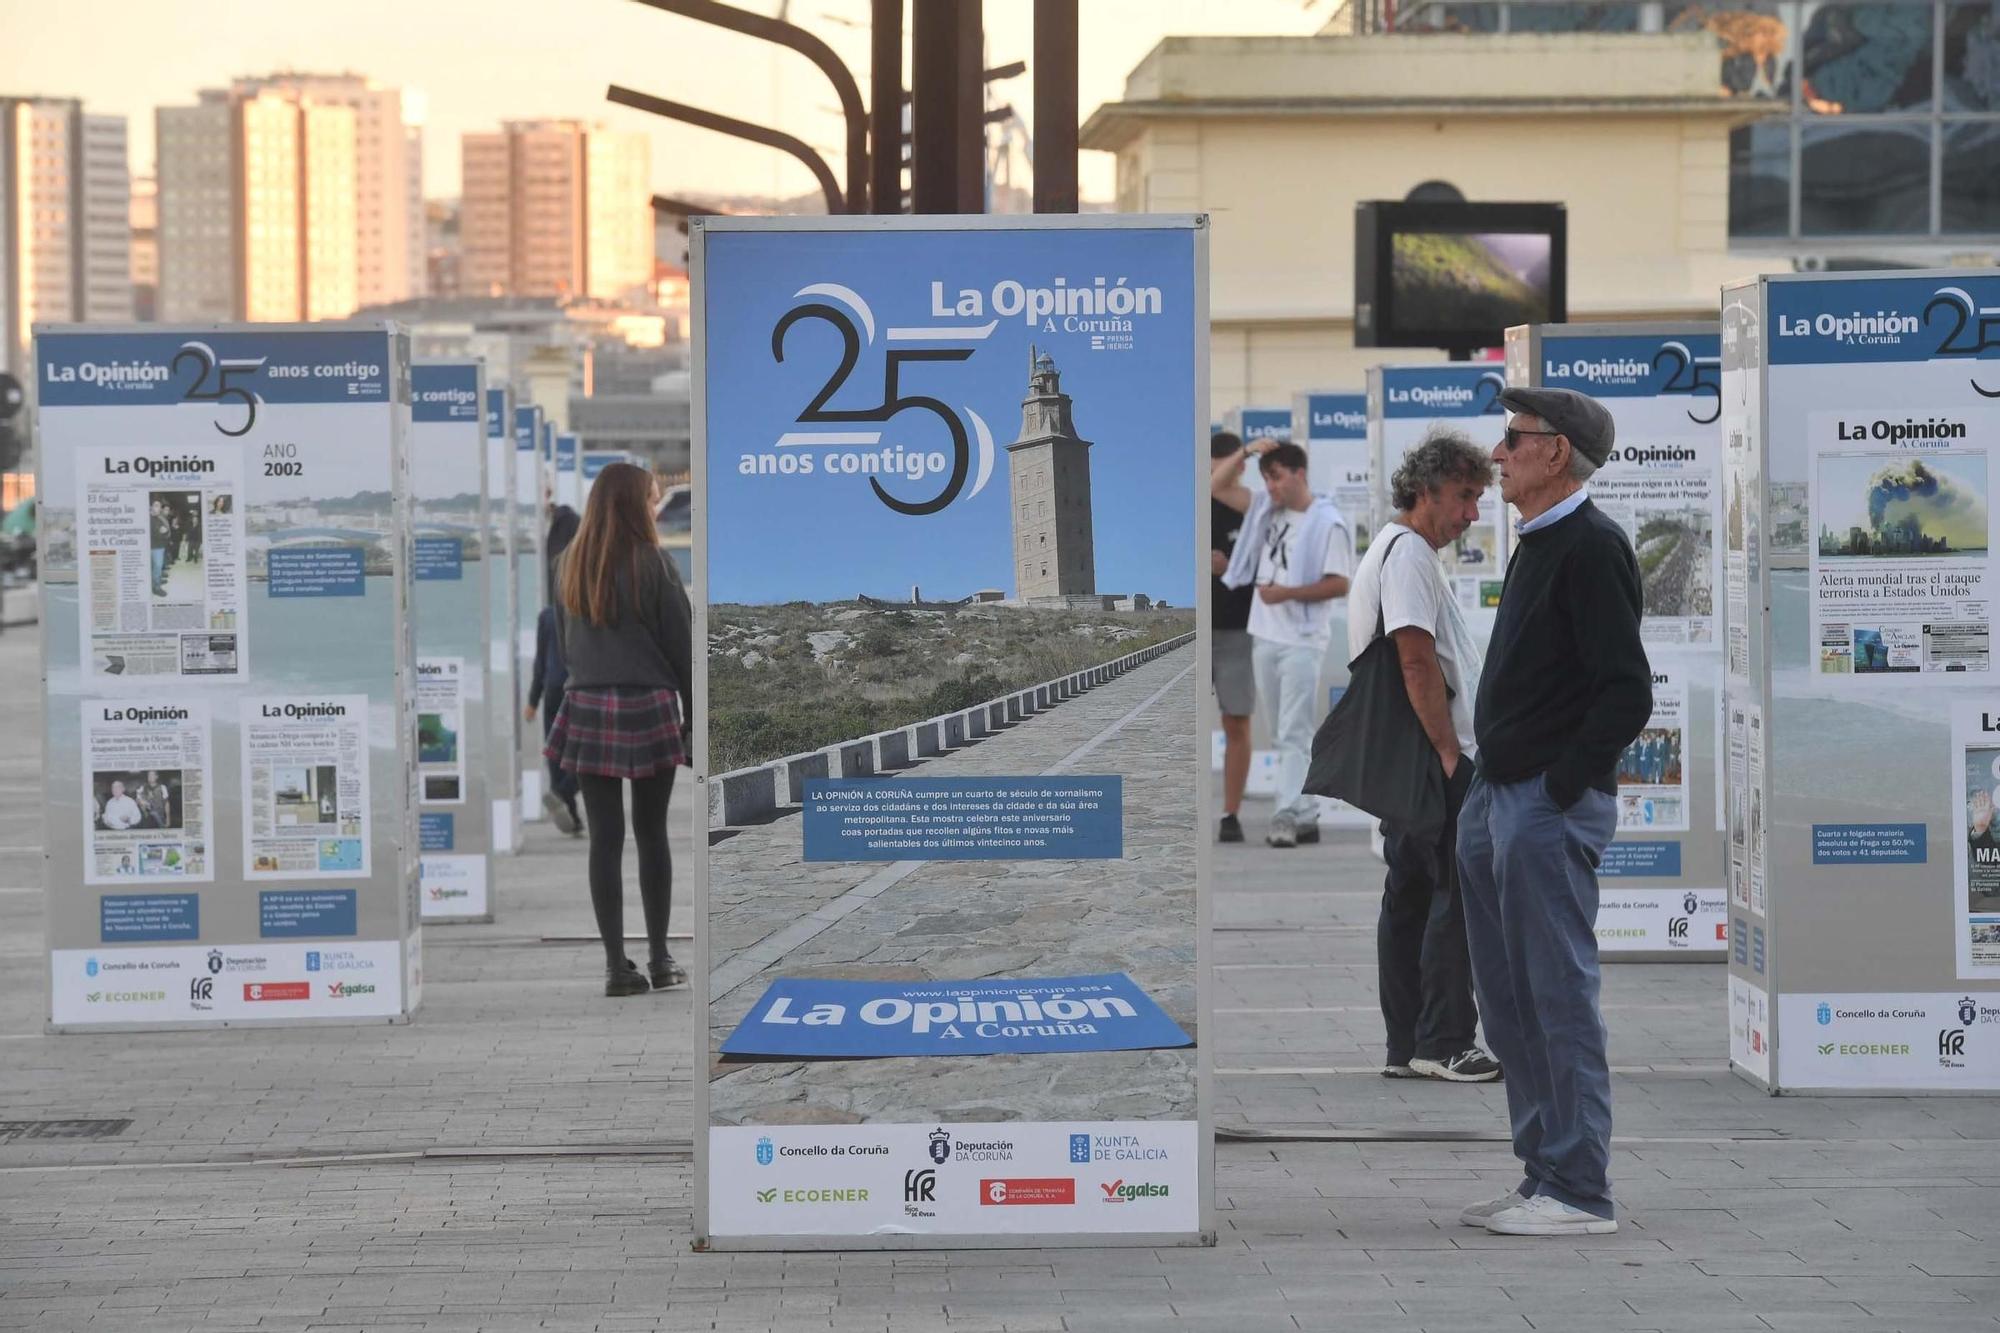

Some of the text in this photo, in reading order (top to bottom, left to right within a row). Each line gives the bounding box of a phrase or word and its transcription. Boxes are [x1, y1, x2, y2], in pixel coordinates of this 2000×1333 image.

[931, 277, 1161, 325] La Opinión
[1042, 316, 1132, 333] A Coruña
[1779, 314, 1810, 337] La
[1815, 311, 1918, 341] Opinión
[1846, 334, 1900, 345] A Coruña
[47, 346, 379, 436] La Opinión 25 anos contigo
[1546, 345, 1721, 424] La Opinión 25
[423, 388, 476, 404] contigo
[1389, 385, 1473, 405] La Opinión
[772, 298, 980, 516] 25
[1314, 411, 1366, 429] La Opin
[1839, 418, 1966, 445] La Opinión
[264, 443, 297, 458] ANO
[1900, 439, 1950, 448] A Coruña
[1624, 445, 1696, 465] Opinión
[104, 455, 215, 478] La Opinión
[264, 462, 303, 477] 2002
[738, 445, 946, 480] anos contigo
[1681, 479, 1707, 487] Coruña
[1819, 573, 1981, 587] Alerta mundial tras el ataque
[1819, 585, 1971, 599] terrorista a Estados Unidos
[104, 706, 188, 724] La Opinión
[263, 702, 346, 720] La Opinión
[811, 791, 823, 800] LA
[826, 789, 864, 800] OPINIÓN
[866, 791, 873, 799] A
[875, 789, 913, 800] CORUÑA
[915, 791, 949, 801] cumpre
[965, 790, 994, 798] cuarto
[996, 789, 1008, 798] de
[1010, 789, 1038, 798] século
[1040, 789, 1052, 798] de
[1054, 788, 1102, 798] xornalismo
[830, 804, 861, 812] servizo
[863, 803, 879, 812] dos
[881, 801, 921, 811] cidadáns
[931, 802, 947, 811] dos
[950, 802, 990, 811] intereses
[992, 801, 1004, 810] da
[1006, 801, 1035, 810] cidade
[1046, 801, 1057, 810] da
[1060, 800, 1076, 809] súa
[1078, 800, 1099, 809] área
[844, 813, 1071, 825] metropolitana. Esta mostra celebra este aniversario
[841, 828, 862, 836] coas
[864, 827, 904, 837] portadas
[906, 828, 923, 837] que
[925, 826, 960, 835] recollen
[963, 826, 992, 837] algúns
[994, 826, 1013, 835] fitos
[1052, 825, 1074, 834] máis
[1817, 830, 1840, 838] Cuarta
[1850, 830, 1875, 838] folgada
[868, 839, 921, 848] salientables
[923, 838, 940, 847] dos
[942, 838, 975, 847] últimos
[977, 837, 1021, 847] vintecinco
[1860, 839, 1880, 847] Fraga
[1633, 901, 1659, 909] Coruña
[324, 952, 354, 960] XUNTA
[324, 960, 374, 970] DE GALICIA
[105, 991, 165, 1002] ECOENER
[328, 982, 375, 997] Vegalsa
[761, 993, 1138, 1034] La Opinión
[1836, 1008, 1926, 1019] Concello da Coruña
[940, 1021, 1098, 1039] A Coruña
[1840, 1044, 1909, 1055] ECOENER
[955, 1140, 1013, 1152] Deputación
[1095, 1136, 1140, 1147] XUNTA
[780, 1144, 889, 1157] Concello da Coruña
[955, 1150, 1013, 1161] DA CORUÑA
[1095, 1149, 1168, 1160] DE GALICIA
[783, 1169, 936, 1202] ECOENER HR
[1101, 1179, 1169, 1201] Vegalsa
